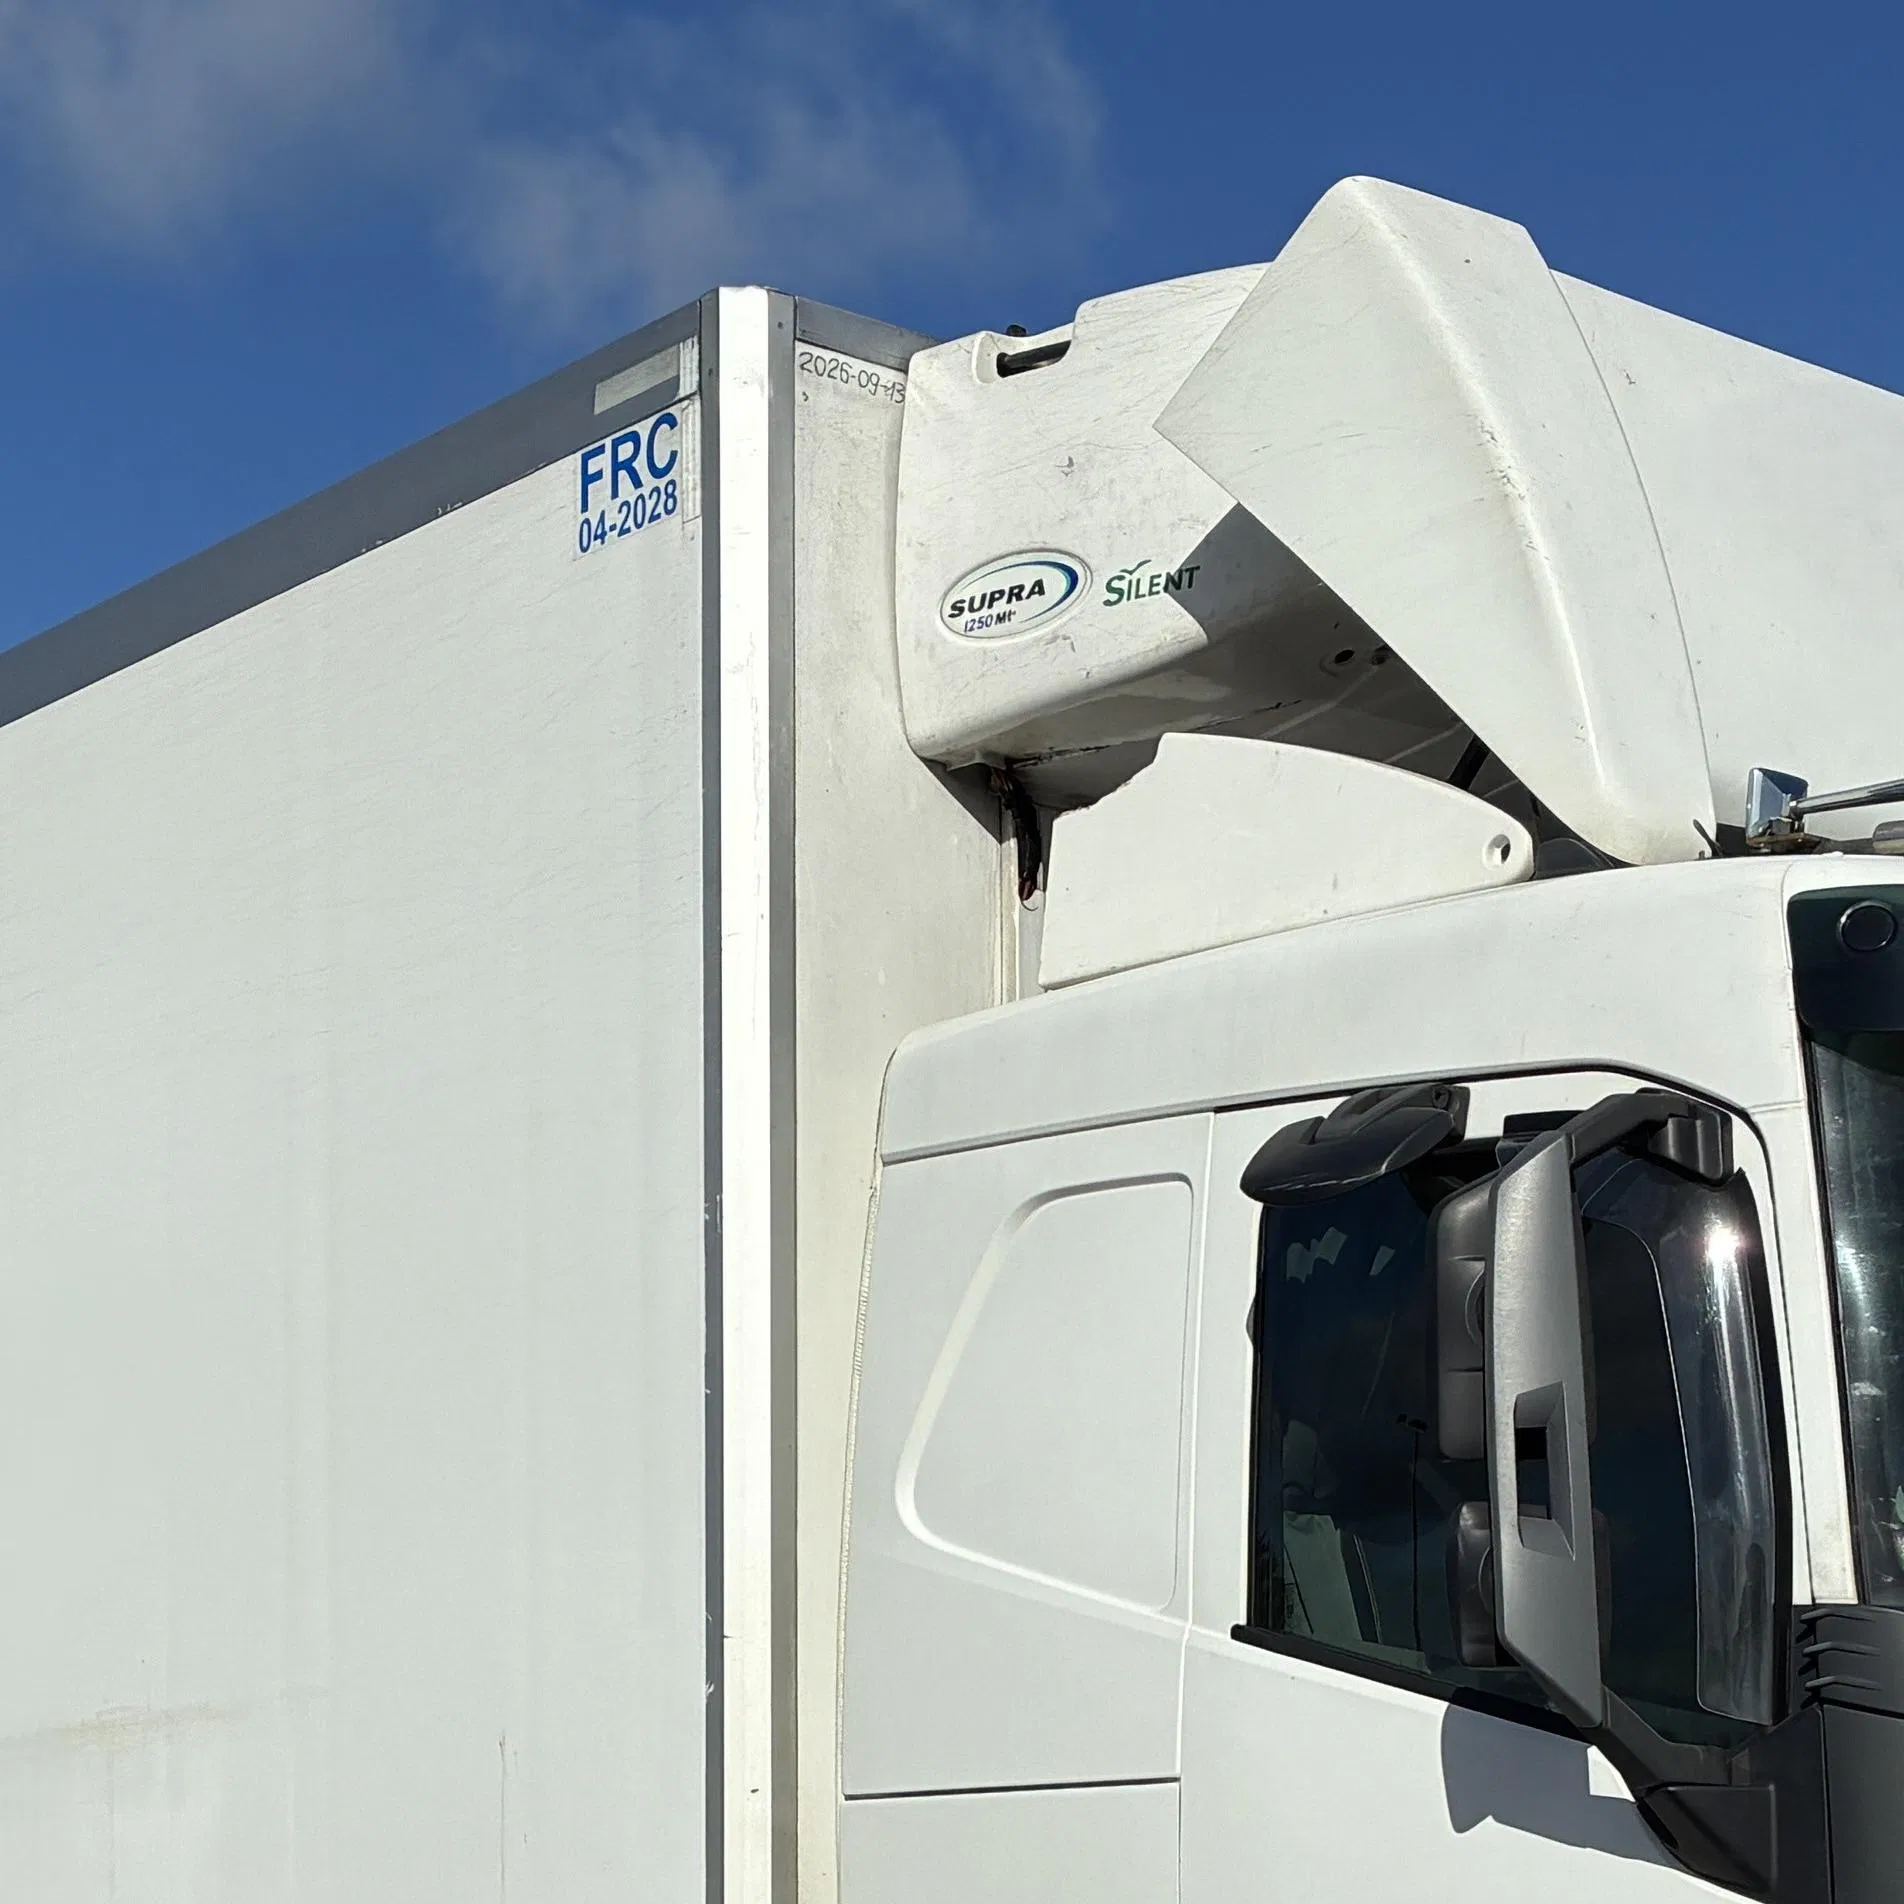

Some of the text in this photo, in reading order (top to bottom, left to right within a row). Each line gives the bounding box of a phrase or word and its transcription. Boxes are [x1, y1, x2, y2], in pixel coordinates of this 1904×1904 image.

[580, 412, 679, 514] FRC
[579, 478, 678, 553] 04-2028
[948, 578, 1046, 619] SUPRA
[1102, 565, 1201, 607] SILENT
[964, 613, 994, 634] 1250
